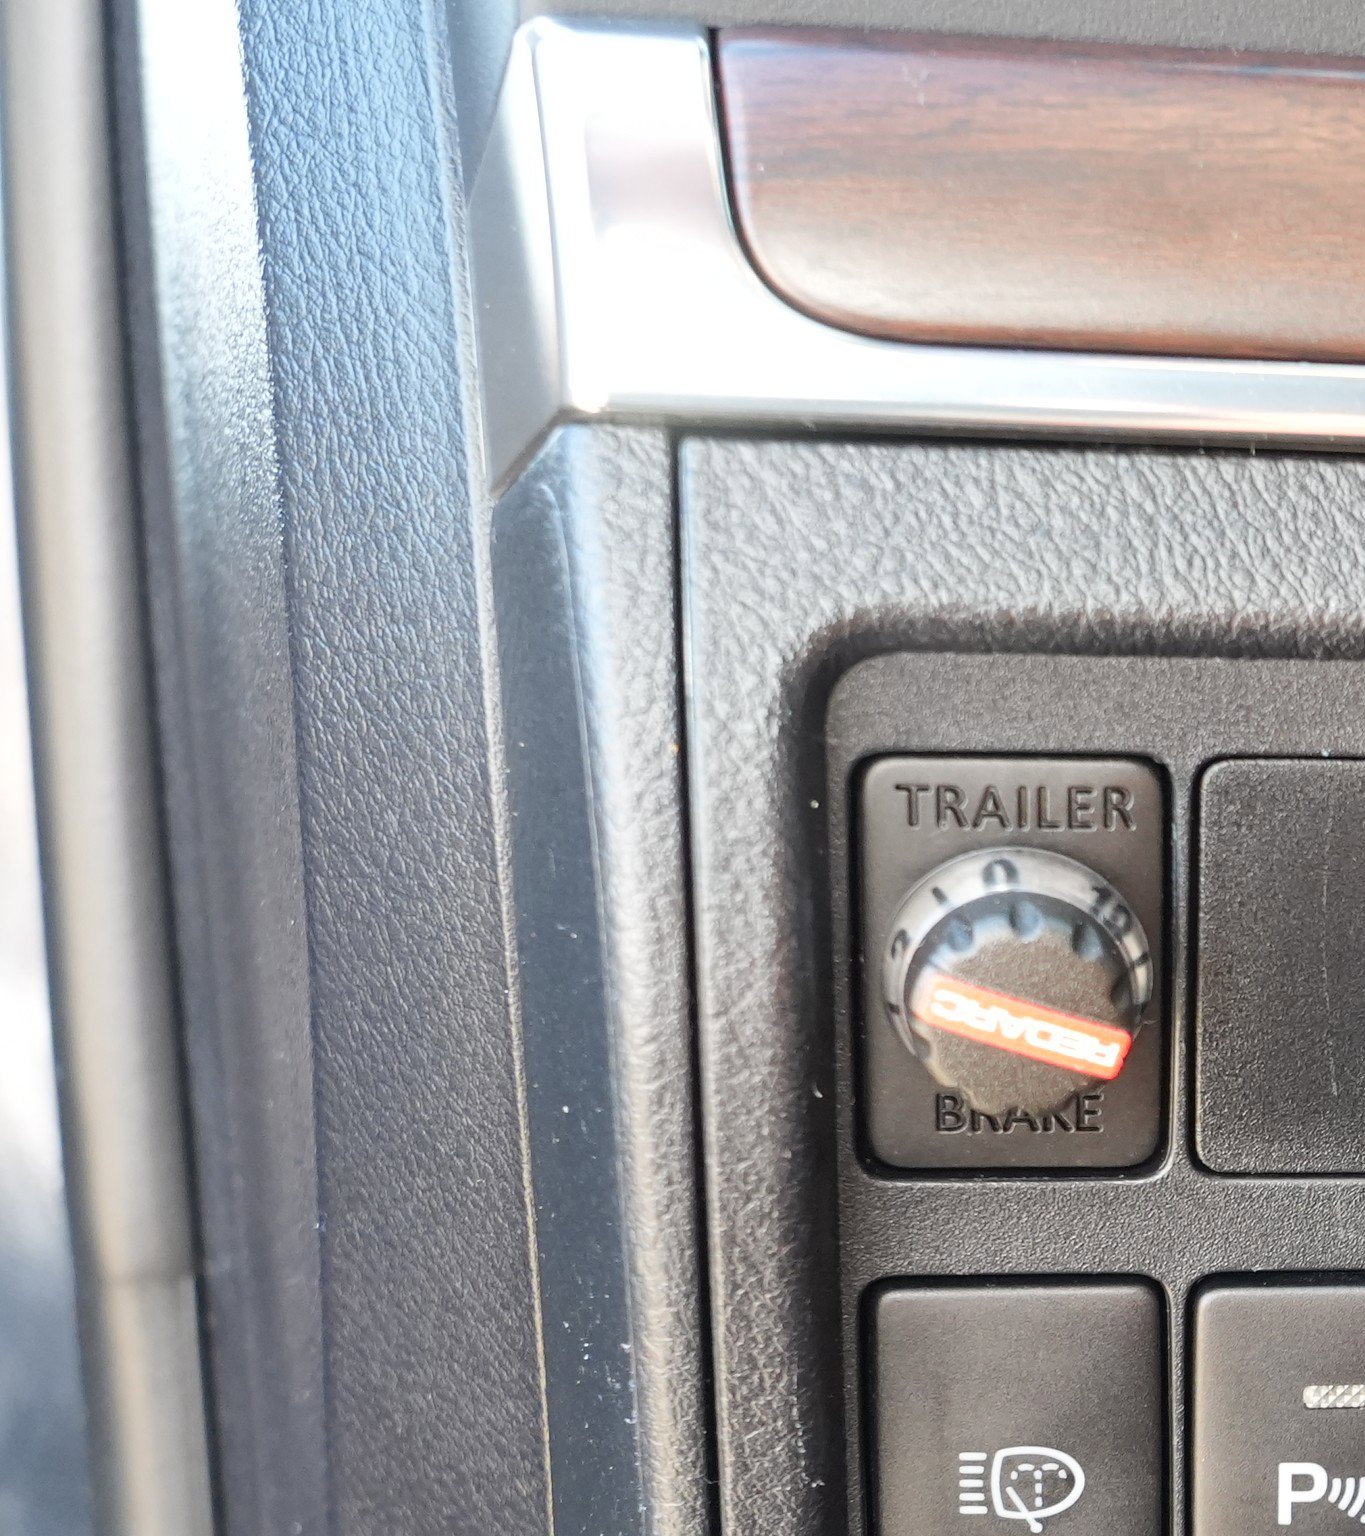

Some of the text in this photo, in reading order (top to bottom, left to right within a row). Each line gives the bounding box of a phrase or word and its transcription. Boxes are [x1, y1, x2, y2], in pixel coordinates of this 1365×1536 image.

[896, 784, 1137, 831] TRAILER
[931, 989, 1121, 1068] REDARC
[1277, 1461, 1329, 1526] P
